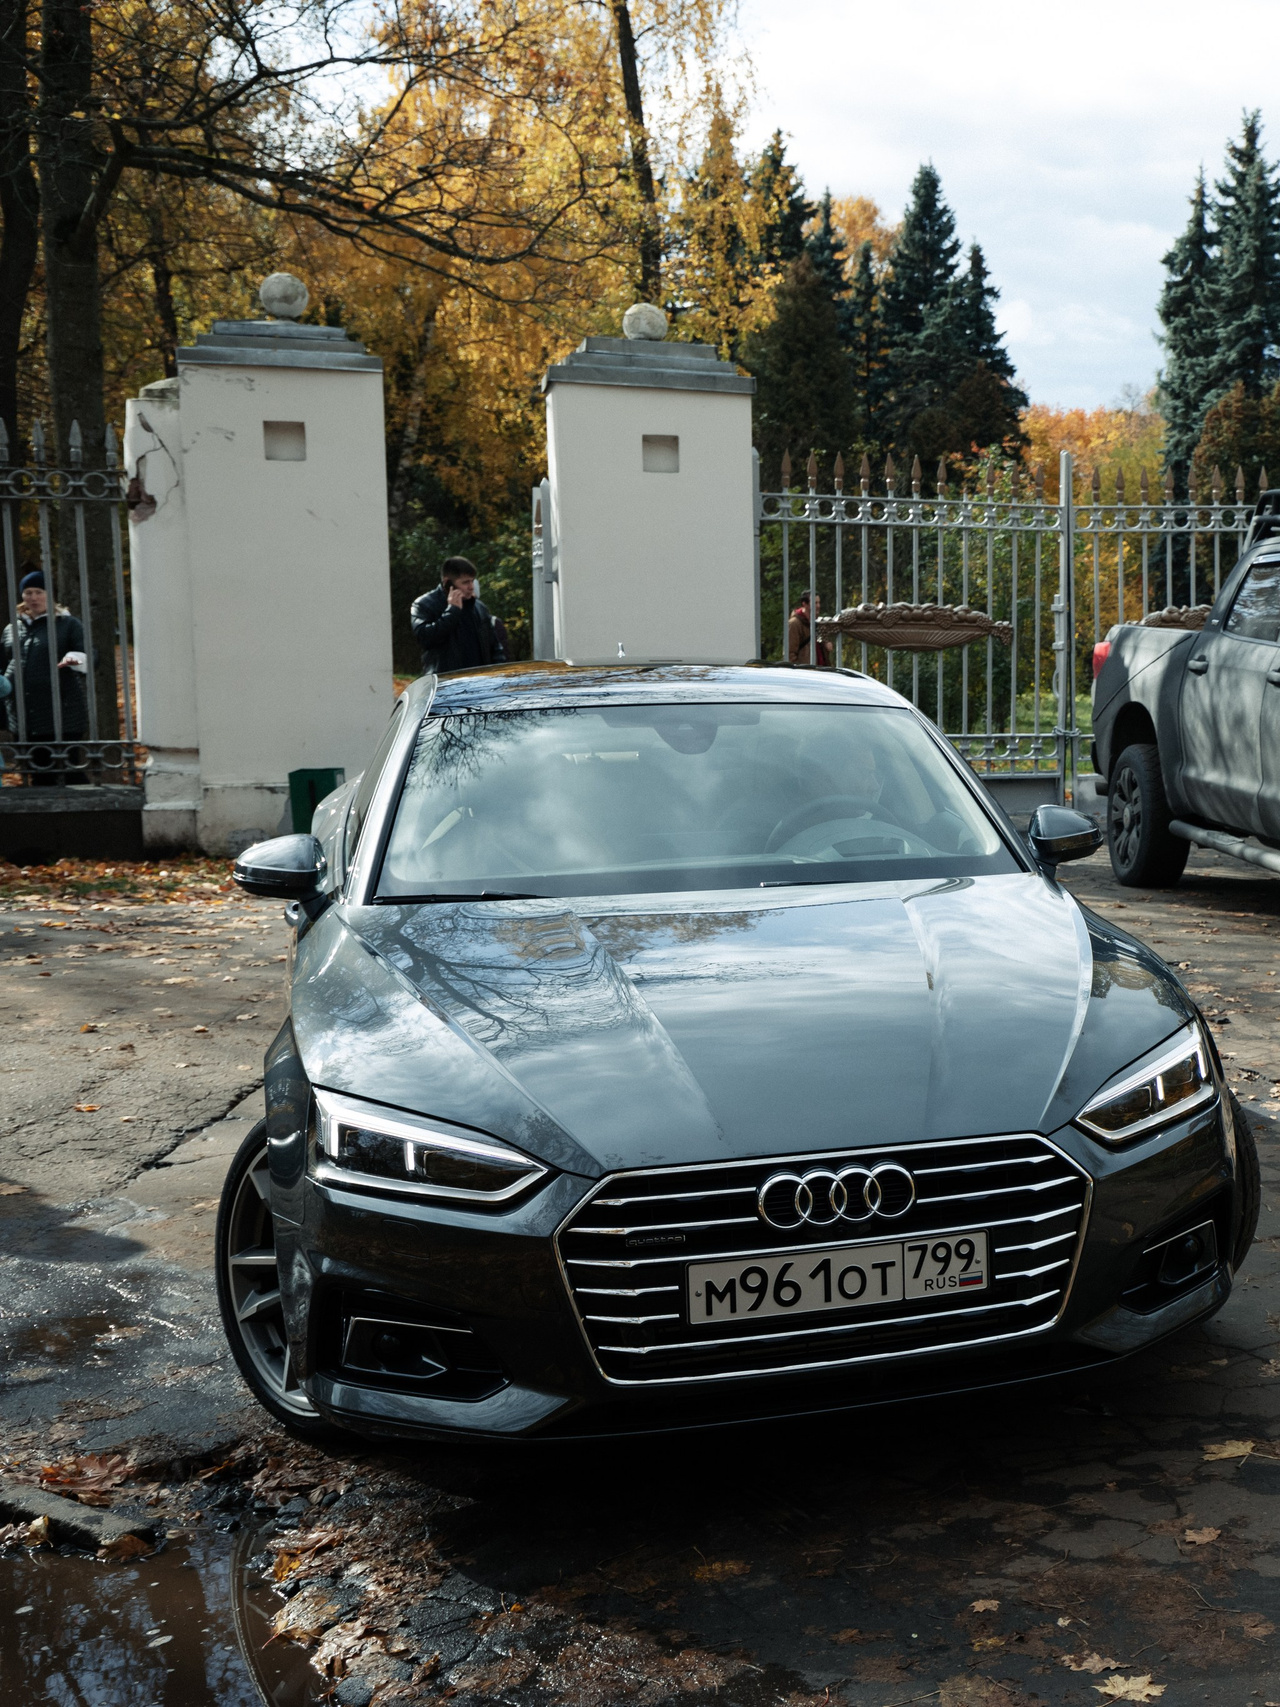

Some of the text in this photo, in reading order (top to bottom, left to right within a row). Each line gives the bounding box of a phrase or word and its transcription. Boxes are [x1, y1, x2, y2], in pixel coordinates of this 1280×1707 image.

[629, 1235, 683, 1246] quattro
[908, 1238, 976, 1279] 799
[924, 1275, 958, 1291] RUS
